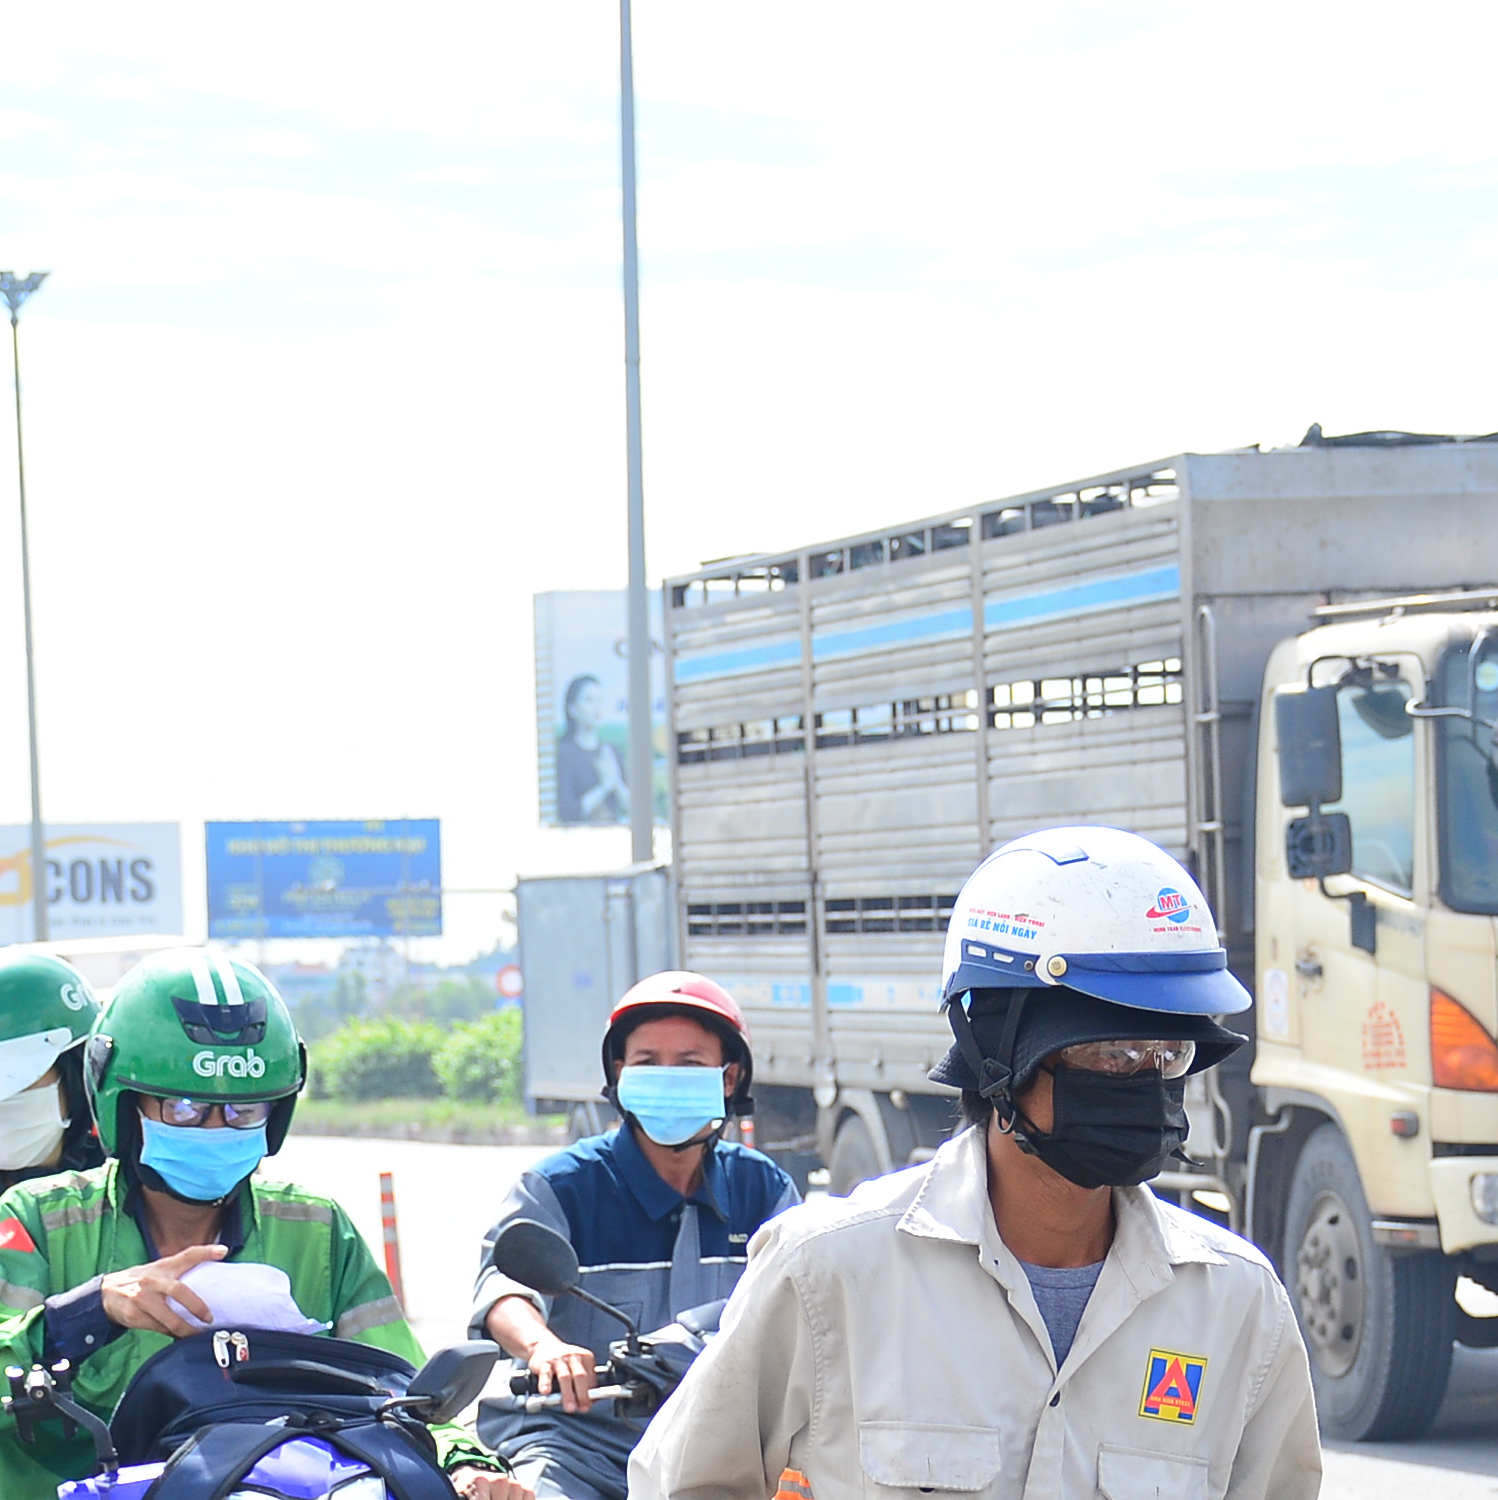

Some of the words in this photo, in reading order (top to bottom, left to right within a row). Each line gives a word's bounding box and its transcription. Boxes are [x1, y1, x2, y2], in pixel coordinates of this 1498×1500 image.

[1160, 894, 1181, 909] MT
[60, 983, 95, 1011] Gr
[193, 1048, 265, 1078] Grab
